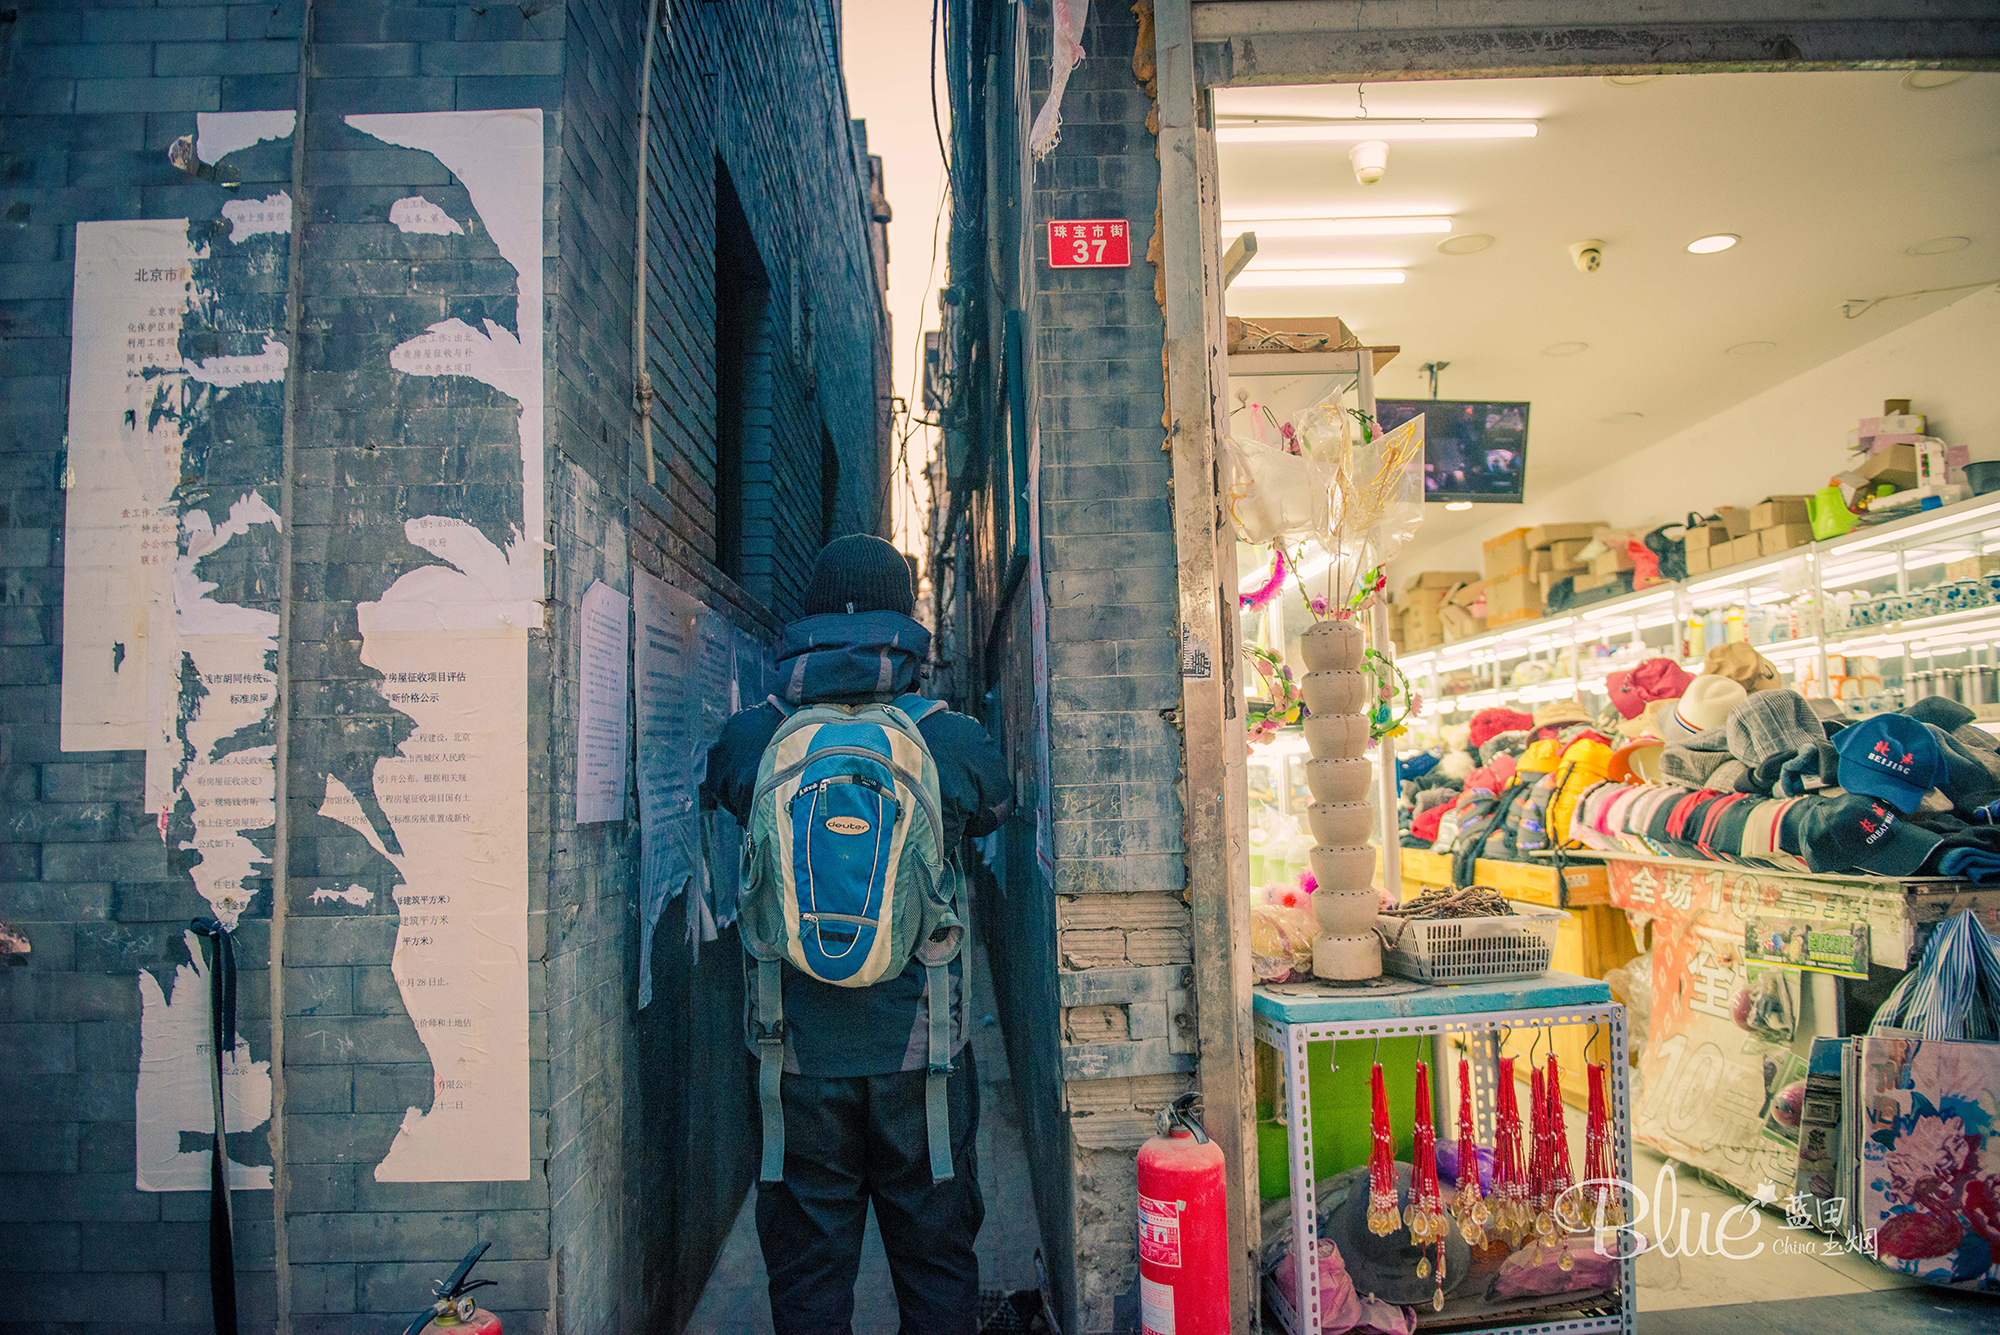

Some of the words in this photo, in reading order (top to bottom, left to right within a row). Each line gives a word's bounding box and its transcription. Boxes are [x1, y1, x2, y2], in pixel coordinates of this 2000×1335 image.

[1053, 224, 1124, 239] 珠宝市街
[1072, 239, 1107, 263] 37
[388, 671, 466, 684] 房屋征收项目评估
[230, 693, 268, 705] 标准房屋
[401, 753, 467, 764] 市西城区人民政
[1867, 752, 1911, 775] BEIJING
[827, 820, 869, 831] deuter
[400, 915, 449, 926] 建筑平方米
